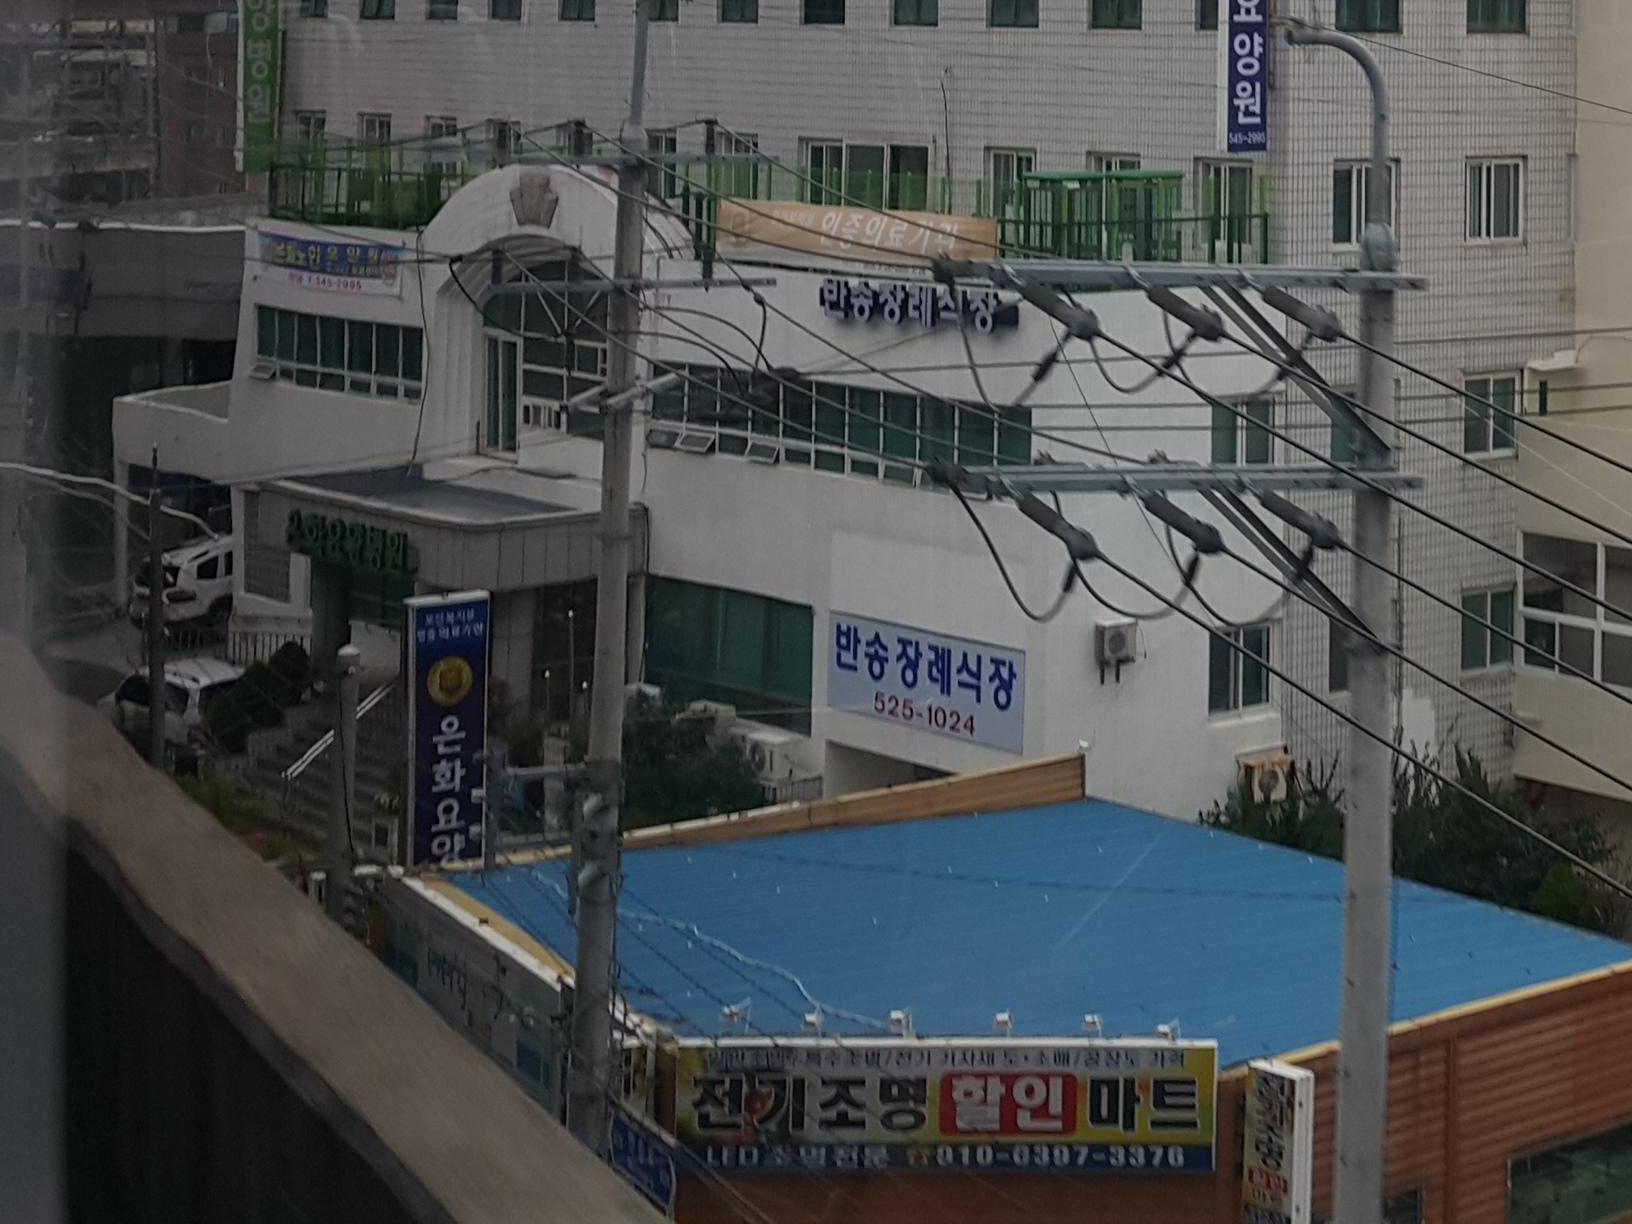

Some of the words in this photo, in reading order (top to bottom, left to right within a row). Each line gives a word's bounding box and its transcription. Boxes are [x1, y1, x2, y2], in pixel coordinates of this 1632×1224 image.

[823, 278, 1000, 335] 반송장례식장
[835, 622, 1017, 712] 반송장례식장
[874, 690, 977, 737] 525-1024
[951, 1075, 1064, 1132] 할인
[1088, 1076, 1199, 1133] 마트
